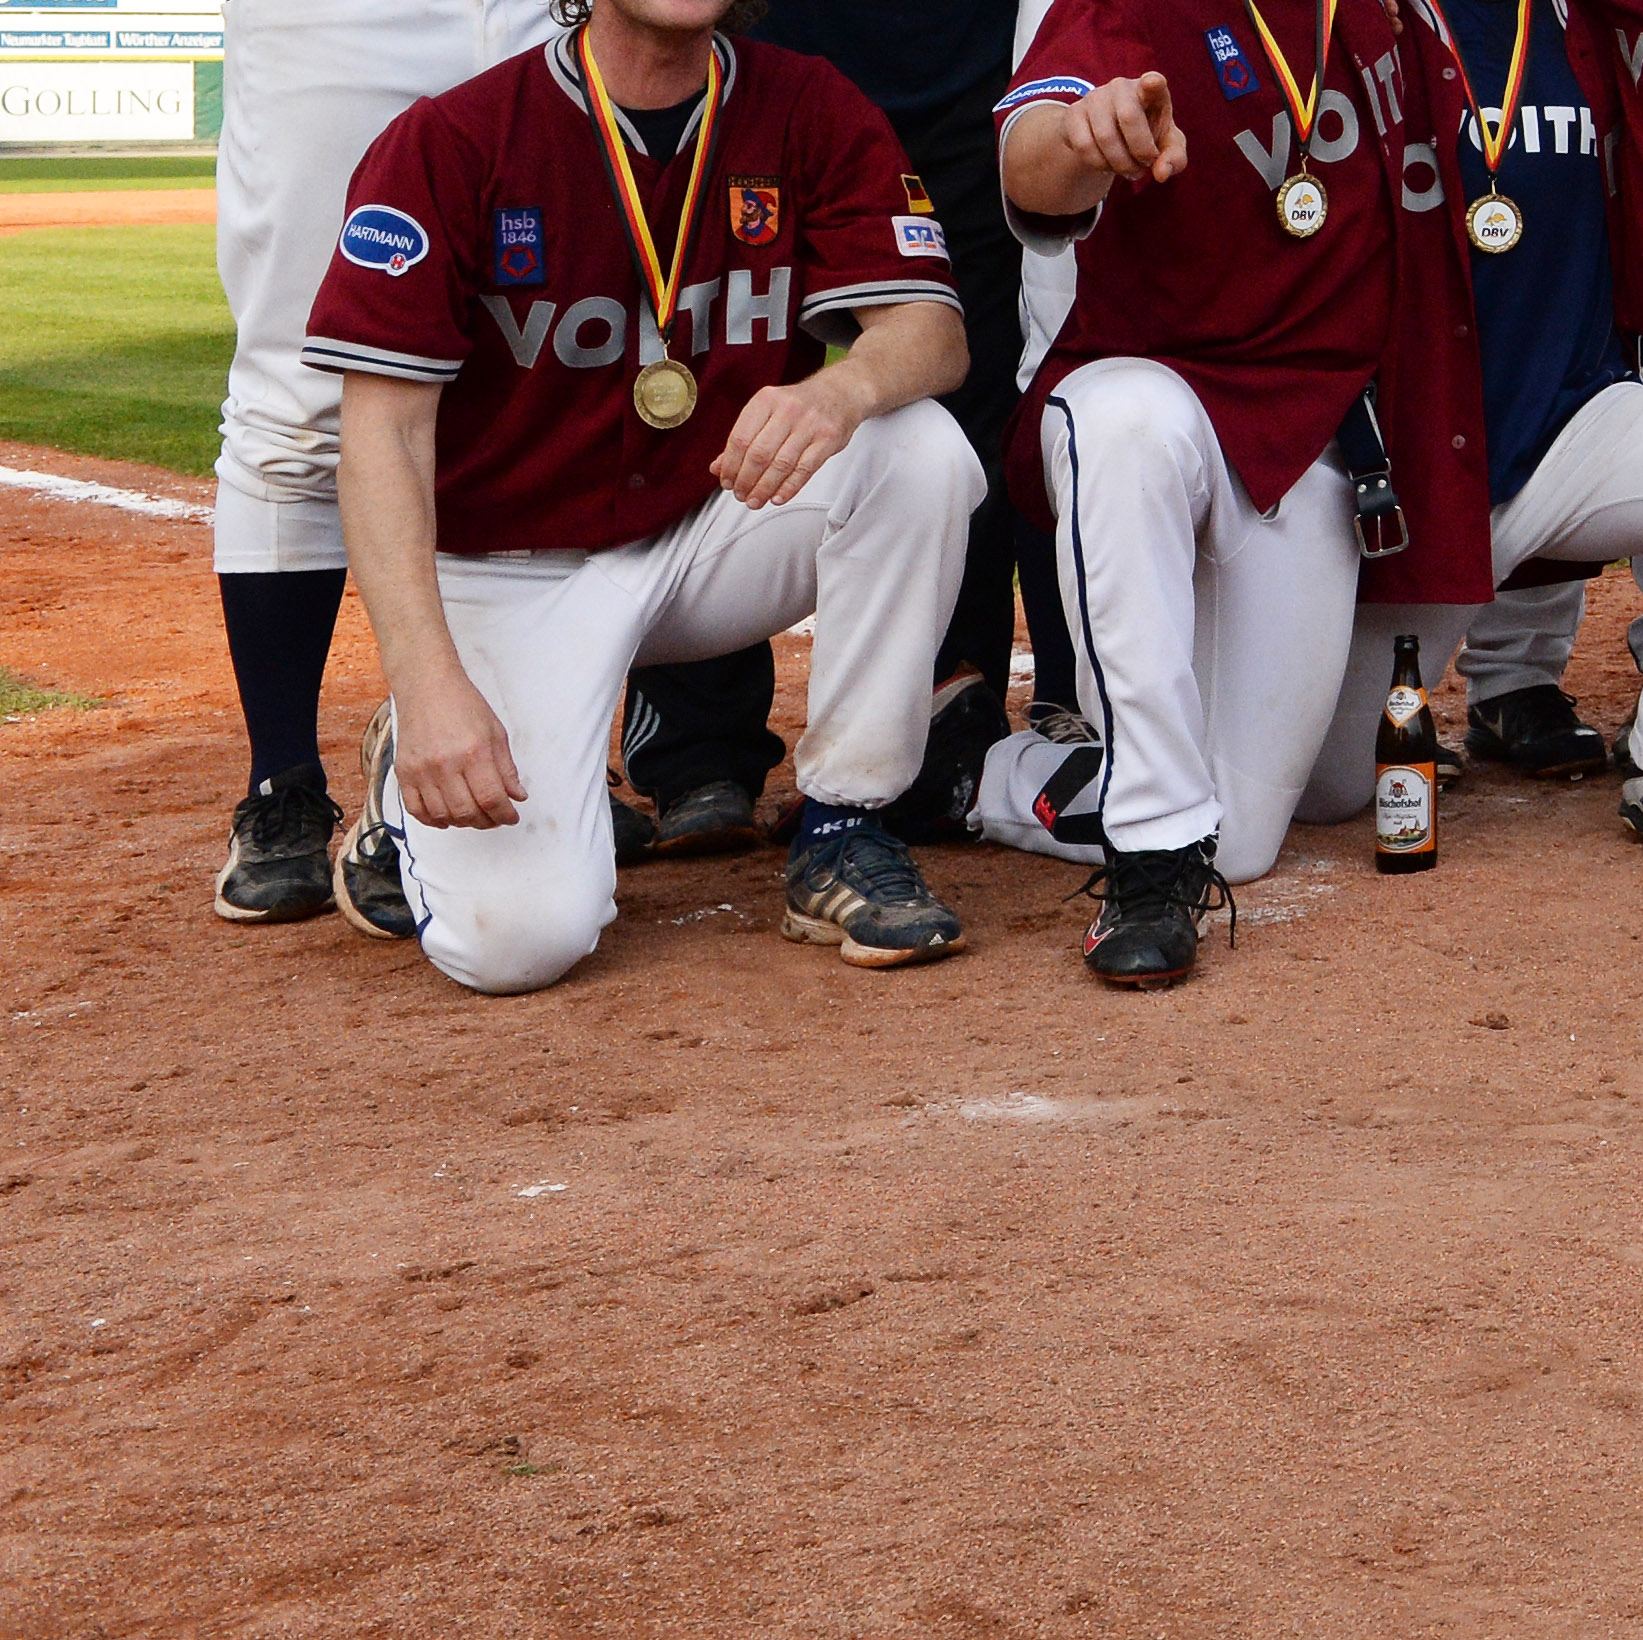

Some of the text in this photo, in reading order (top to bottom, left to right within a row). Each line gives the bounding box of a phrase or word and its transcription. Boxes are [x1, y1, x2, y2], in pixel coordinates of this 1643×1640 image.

[1209, 32, 1232, 52] hsb
[1214, 45, 1239, 61] 1846
[501, 213, 535, 231] hsb
[1291, 209, 1315, 222] DBV
[348, 224, 414, 251] HARTMANN
[501, 230, 536, 246] 1846
[1481, 227, 1509, 239] DBV
[480, 266, 791, 369] VOITH
[1379, 797, 1422, 810] Bischofshof
